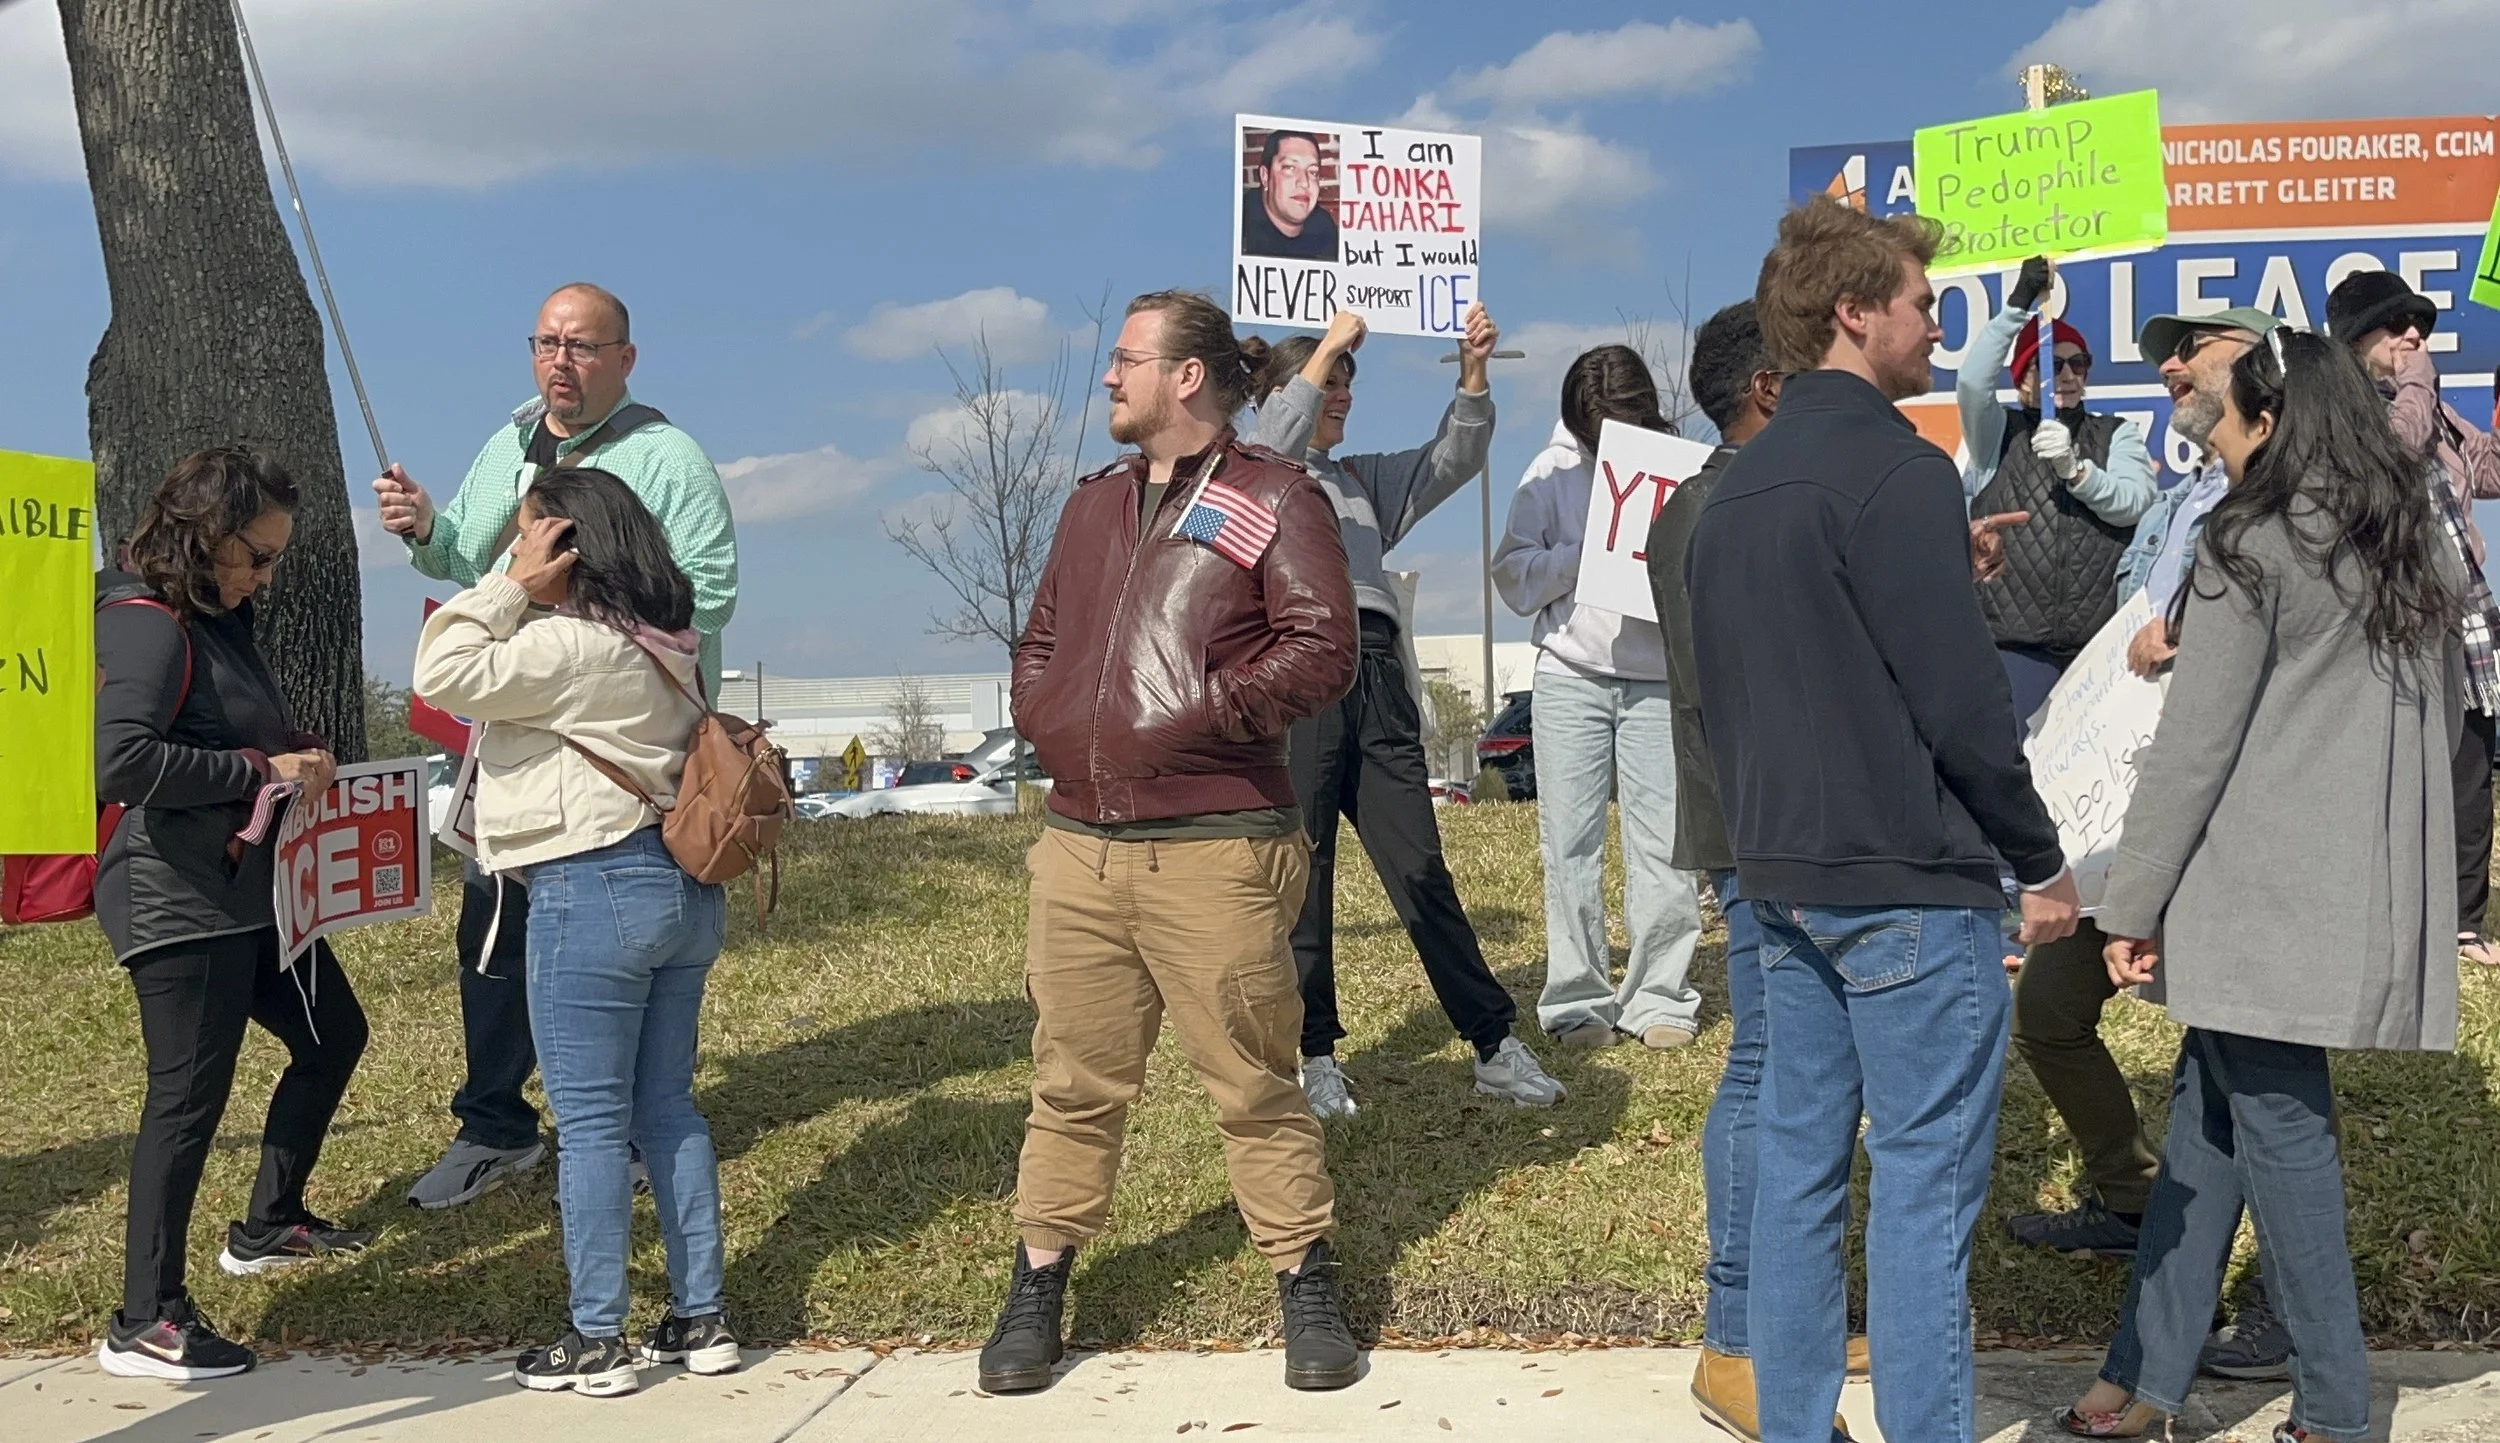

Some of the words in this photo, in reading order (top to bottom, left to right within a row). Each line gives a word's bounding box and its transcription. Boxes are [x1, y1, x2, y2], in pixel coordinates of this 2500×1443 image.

[1362, 131, 1385, 160] I
[1407, 141, 1454, 166] am
[1944, 120, 2093, 164] Trump
[2161, 137, 2281, 166] NICHOLAS
[2288, 133, 2429, 162] FOURAKER,
[2435, 131, 2494, 158] CCIM
[1347, 164, 1454, 200] TONKA
[1937, 149, 2121, 212] Pedophile
[2163, 180, 2269, 207] ARRETT
[2278, 176, 2396, 204] GLEITER
[1341, 201, 1465, 233] JAHARI
[1345, 239, 1384, 267] but
[1395, 243, 1415, 267] I
[1421, 238, 1478, 267] would
[1237, 264, 1339, 322] NEVER
[1346, 285, 1414, 309] SUPPORT
[1418, 274, 1472, 333] ICE
[1929, 269, 2067, 371] OR
[0, 497, 92, 541] IBLE
[279, 826, 361, 950] ICE
